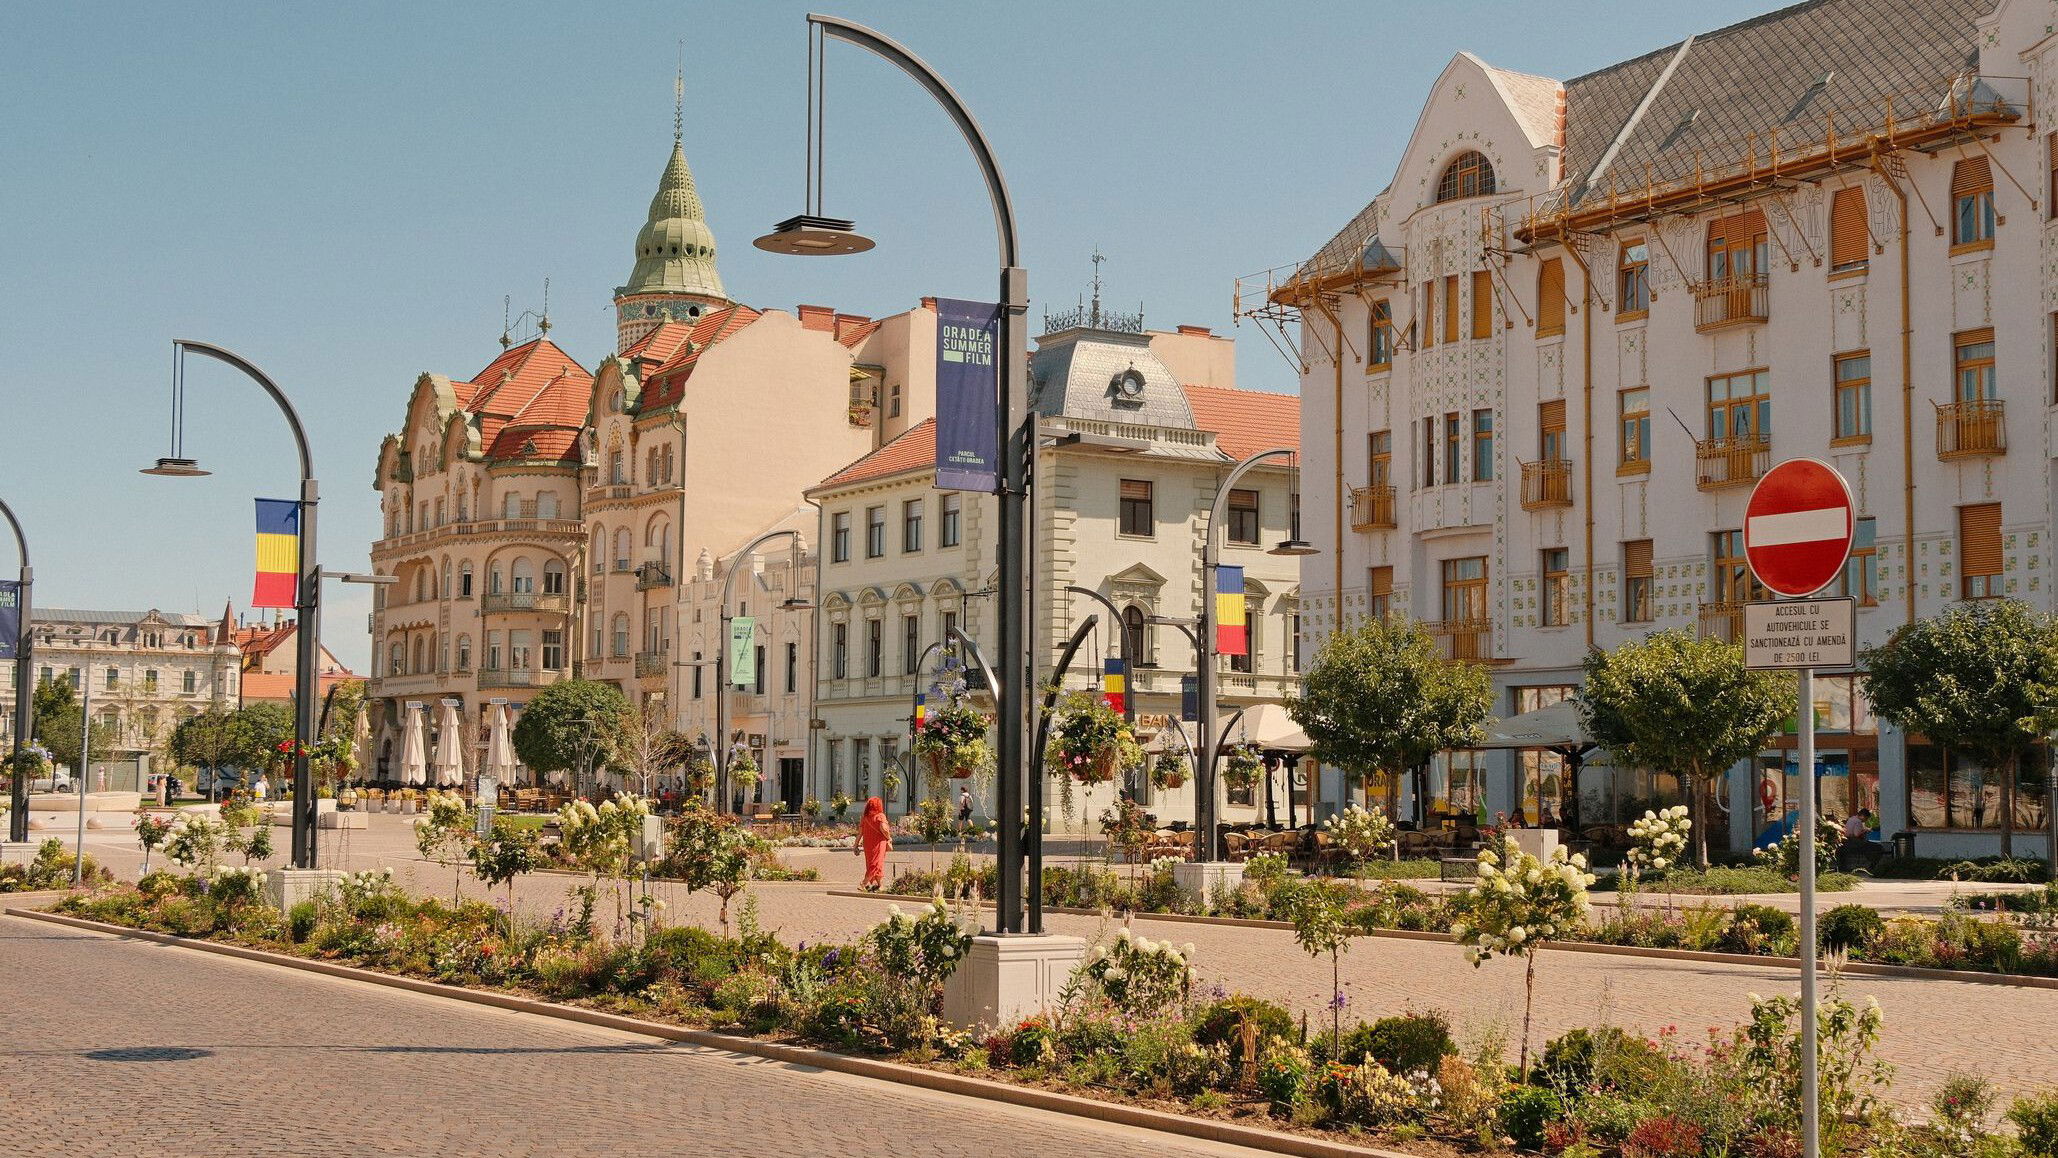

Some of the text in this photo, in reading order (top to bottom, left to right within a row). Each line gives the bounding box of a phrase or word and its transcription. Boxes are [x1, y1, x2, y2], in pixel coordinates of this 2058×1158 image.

[943, 325, 991, 342] ORADEA
[943, 338, 991, 354] SUMMER
[965, 352, 991, 366] FILM
[1775, 604, 1820, 617] ACCESUL CU
[1766, 620, 1829, 632] AUTOVEHICULE SE
[1803, 636, 1814, 647] CU
[1817, 633, 1846, 646] AMENDĂ
[1773, 653, 1782, 663] DE
[1786, 652, 1805, 662] 2500
[1141, 714, 1171, 728] BAN
